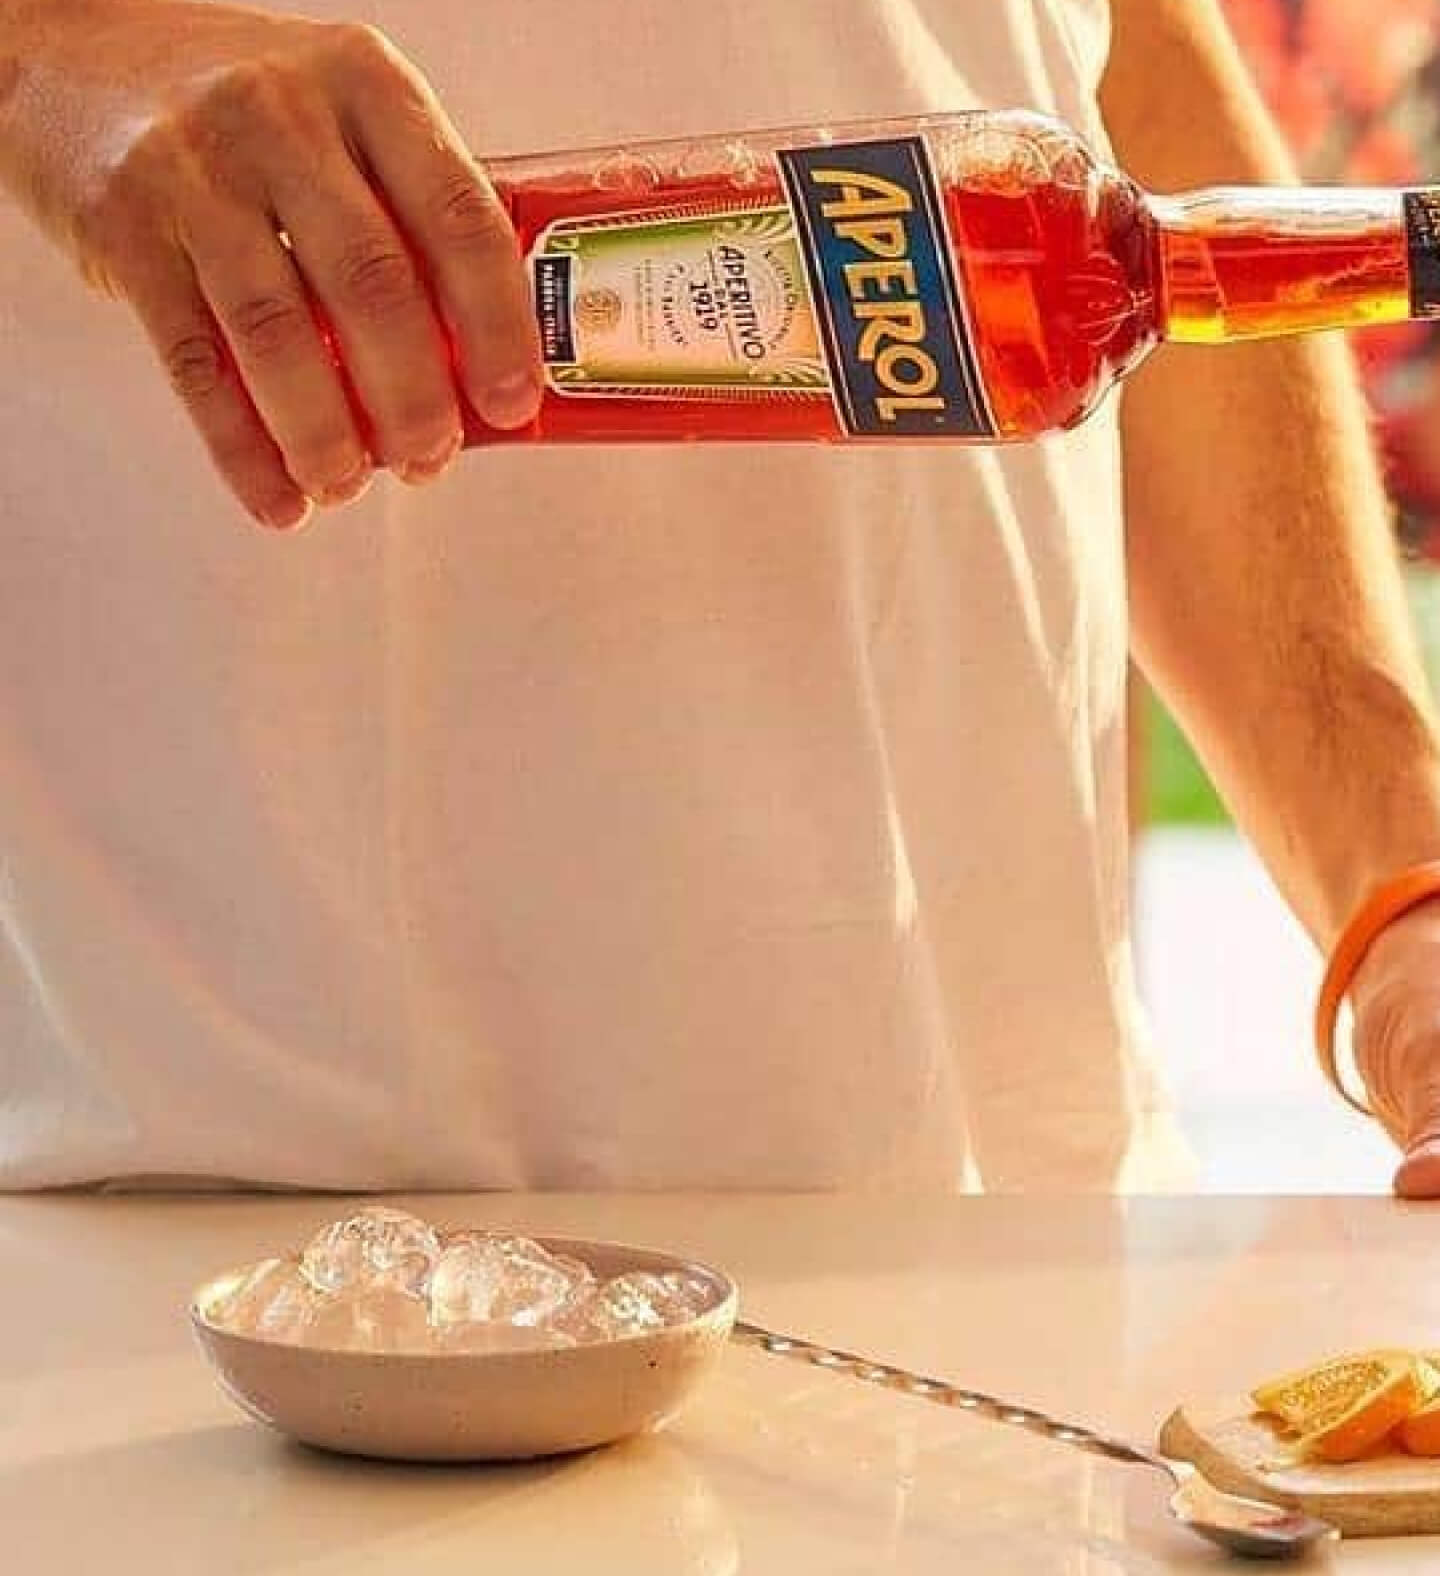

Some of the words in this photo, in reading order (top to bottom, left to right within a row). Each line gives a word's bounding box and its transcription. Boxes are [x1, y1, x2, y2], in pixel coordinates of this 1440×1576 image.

[689, 281, 719, 330] 1919
[720, 245, 767, 359] APERITIVO
[810, 168, 945, 421] APEROL
